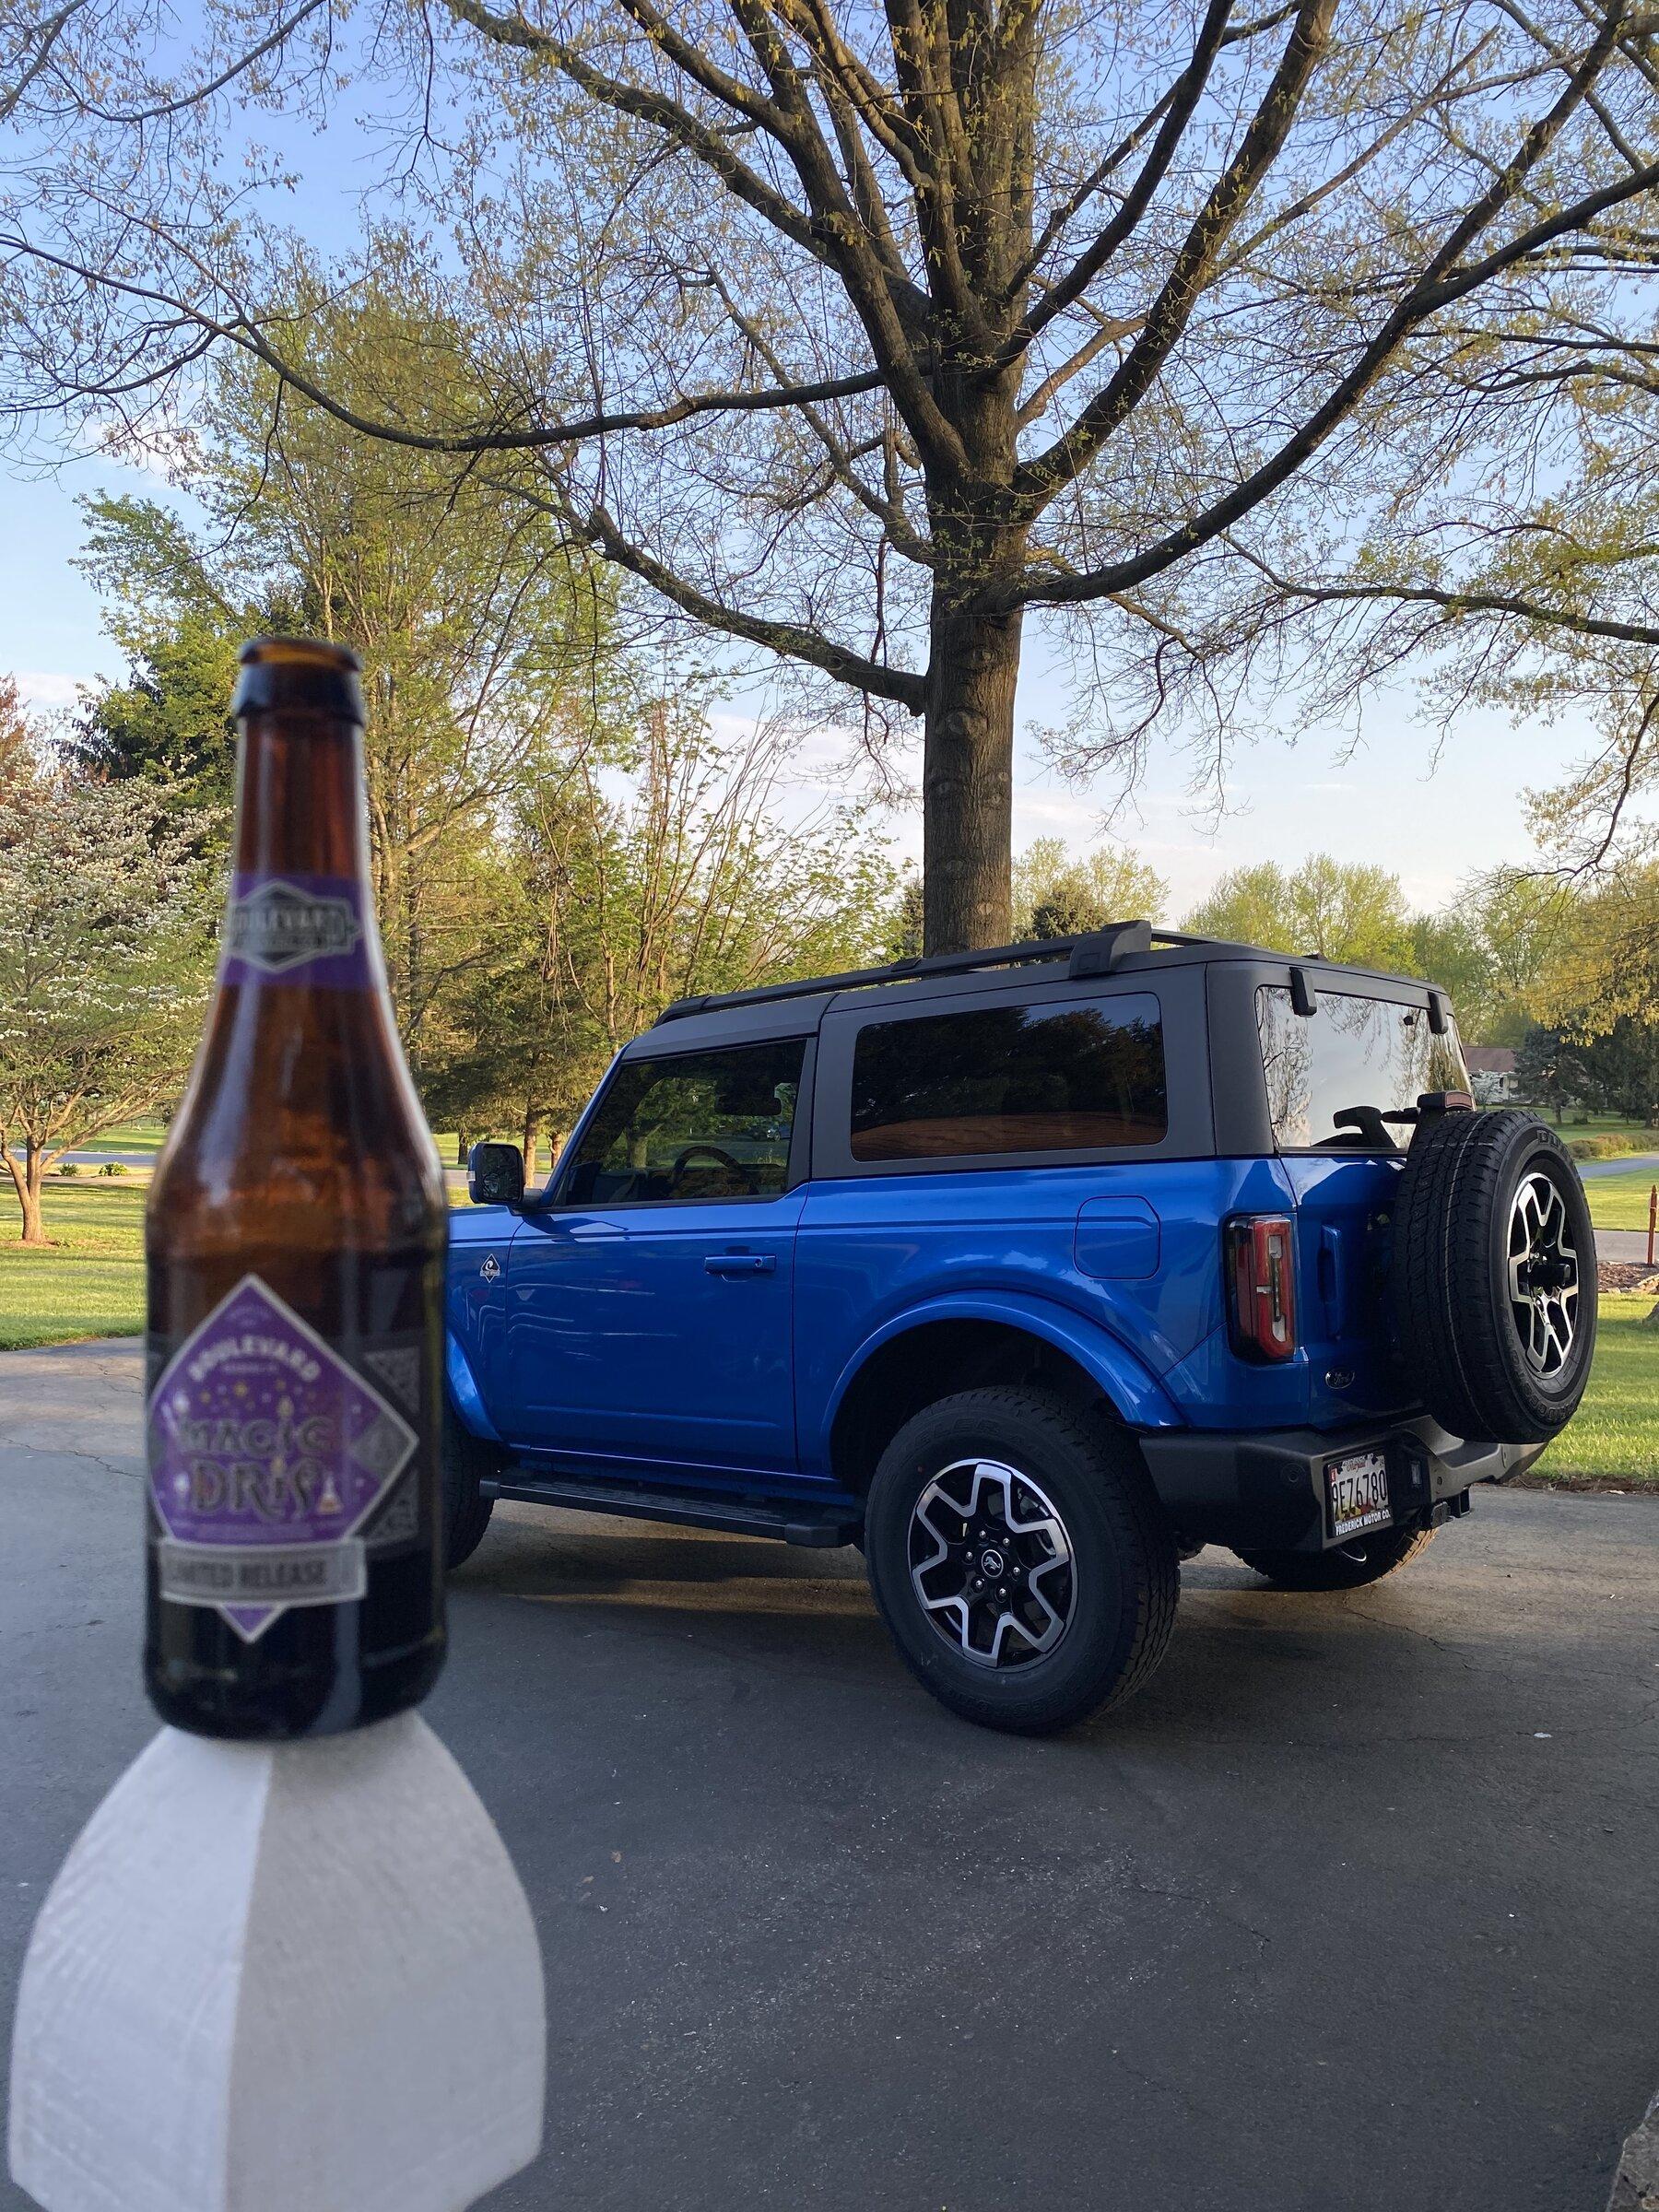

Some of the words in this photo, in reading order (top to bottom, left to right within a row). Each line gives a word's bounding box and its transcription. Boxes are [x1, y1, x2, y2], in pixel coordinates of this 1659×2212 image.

[179, 1415, 335, 1458] MAGIC
[1335, 1516, 1363, 1535] FREDERICK
[1364, 1512, 1382, 1525] MOTOR
